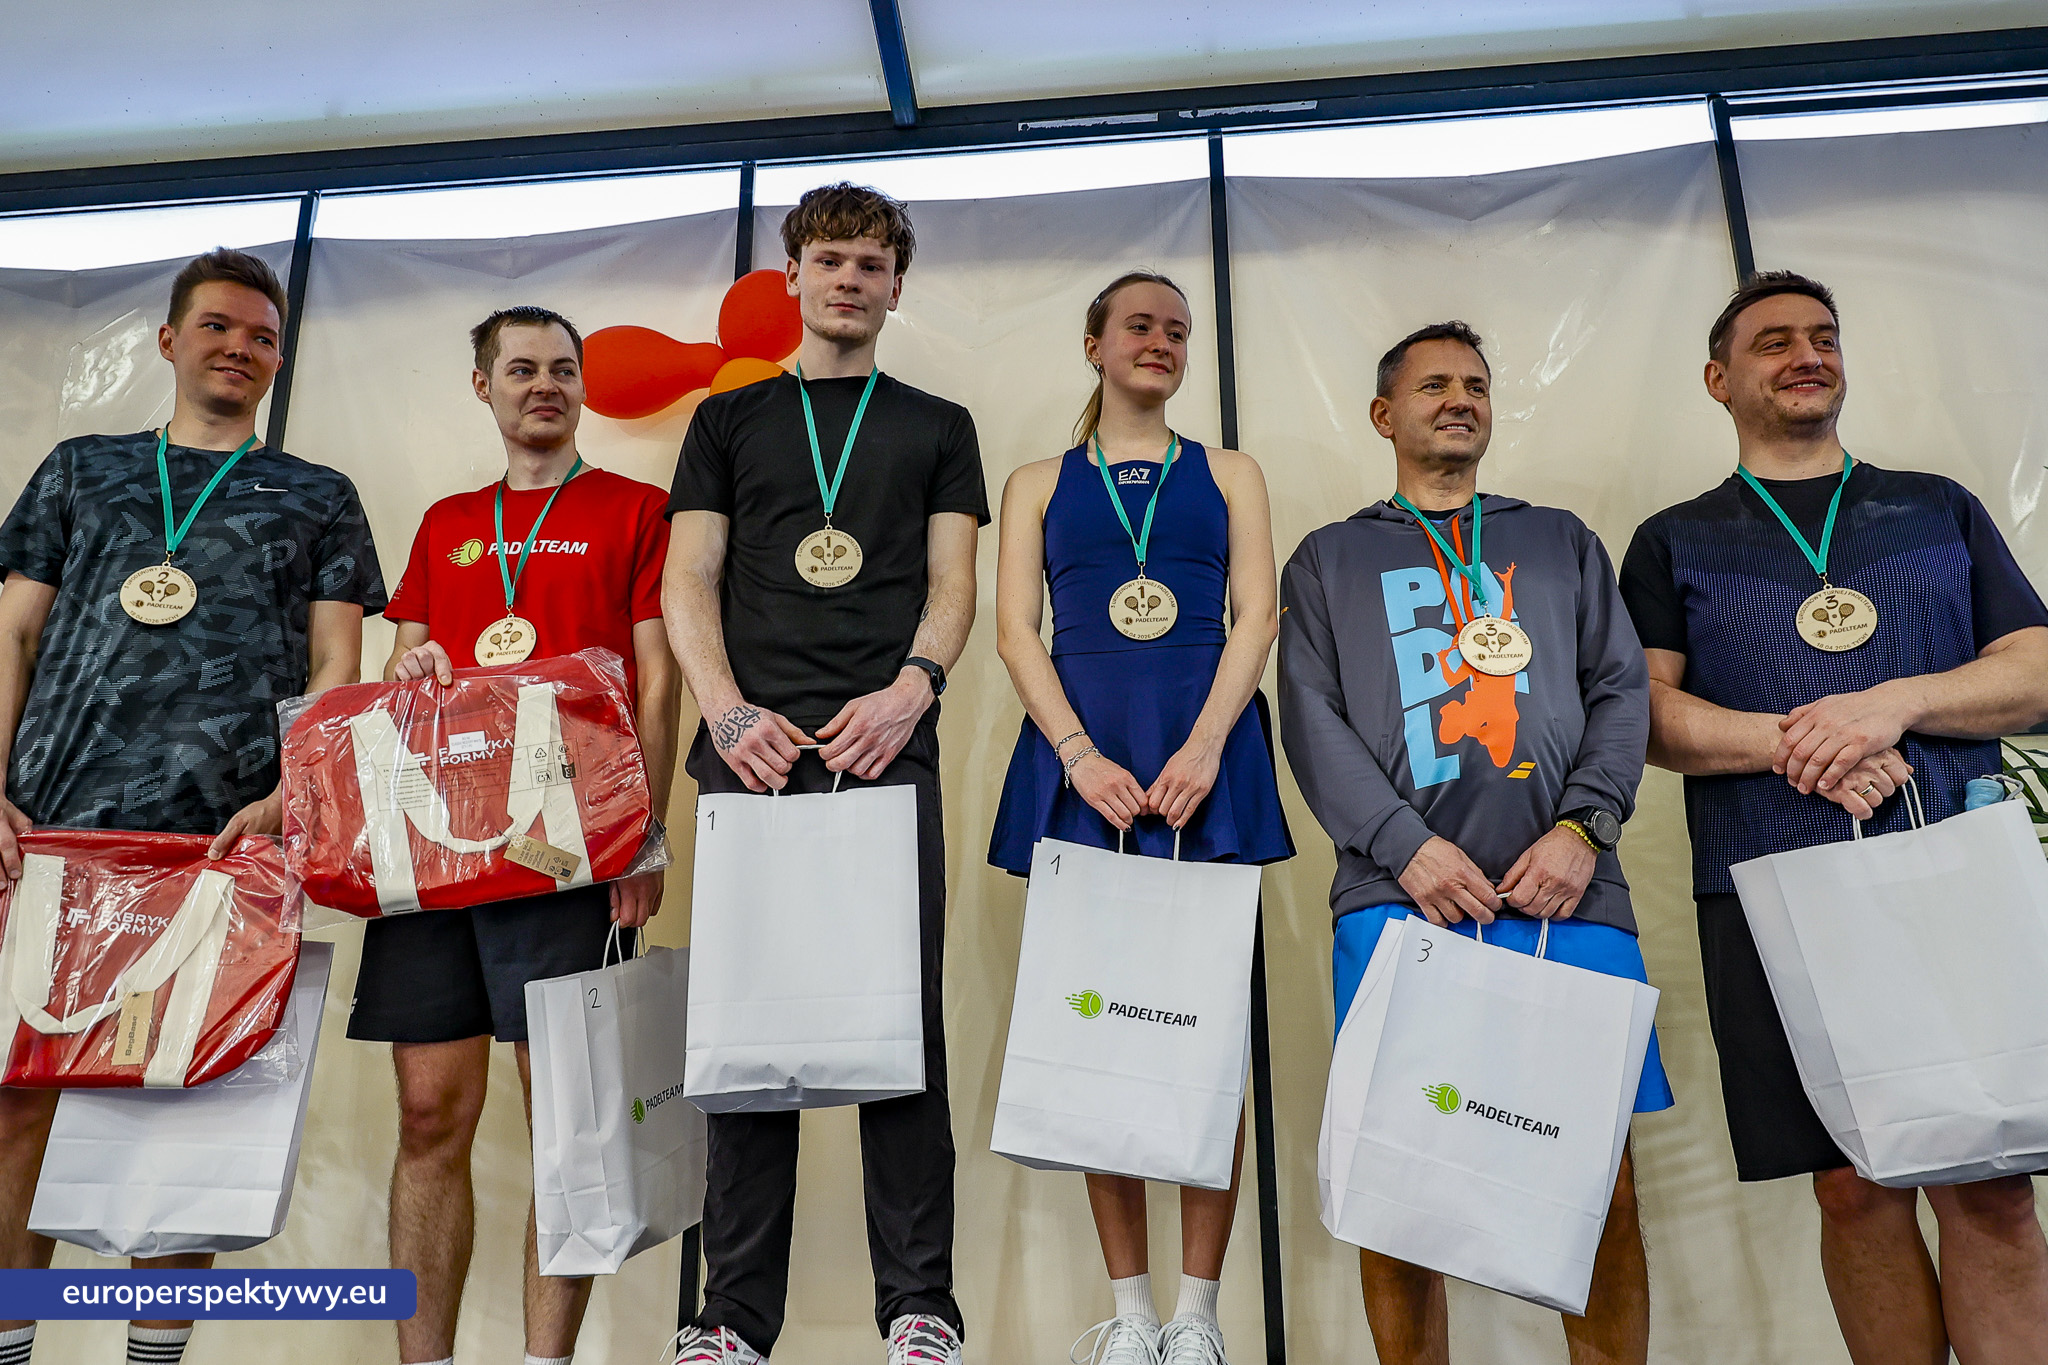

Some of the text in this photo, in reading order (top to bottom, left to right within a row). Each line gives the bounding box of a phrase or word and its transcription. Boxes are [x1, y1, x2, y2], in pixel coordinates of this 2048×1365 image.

[1118, 467, 1150, 481] EA7
[824, 536, 831, 548] 1
[156, 571, 170, 584] 2
[1137, 585, 1145, 599] 1
[146, 602, 184, 610] PADELTEAM
[1825, 595, 1839, 610] 3
[503, 622, 514, 634] 2
[1485, 623, 1498, 636] 3
[1829, 623, 1868, 635] PADELTEAM
[440, 750, 496, 767] FORMY
[707, 810, 716, 831] 1
[1050, 854, 1061, 875] 1
[97, 920, 159, 937] FORMY
[1417, 938, 1433, 962] 3
[587, 987, 602, 1009] 2
[1107, 1001, 1198, 1028] PADELTEAM
[125, 1016, 138, 1056] BagBase
[645, 1082, 684, 1112] PADELTEAM
[1465, 1099, 1560, 1139] PADELTEAM
